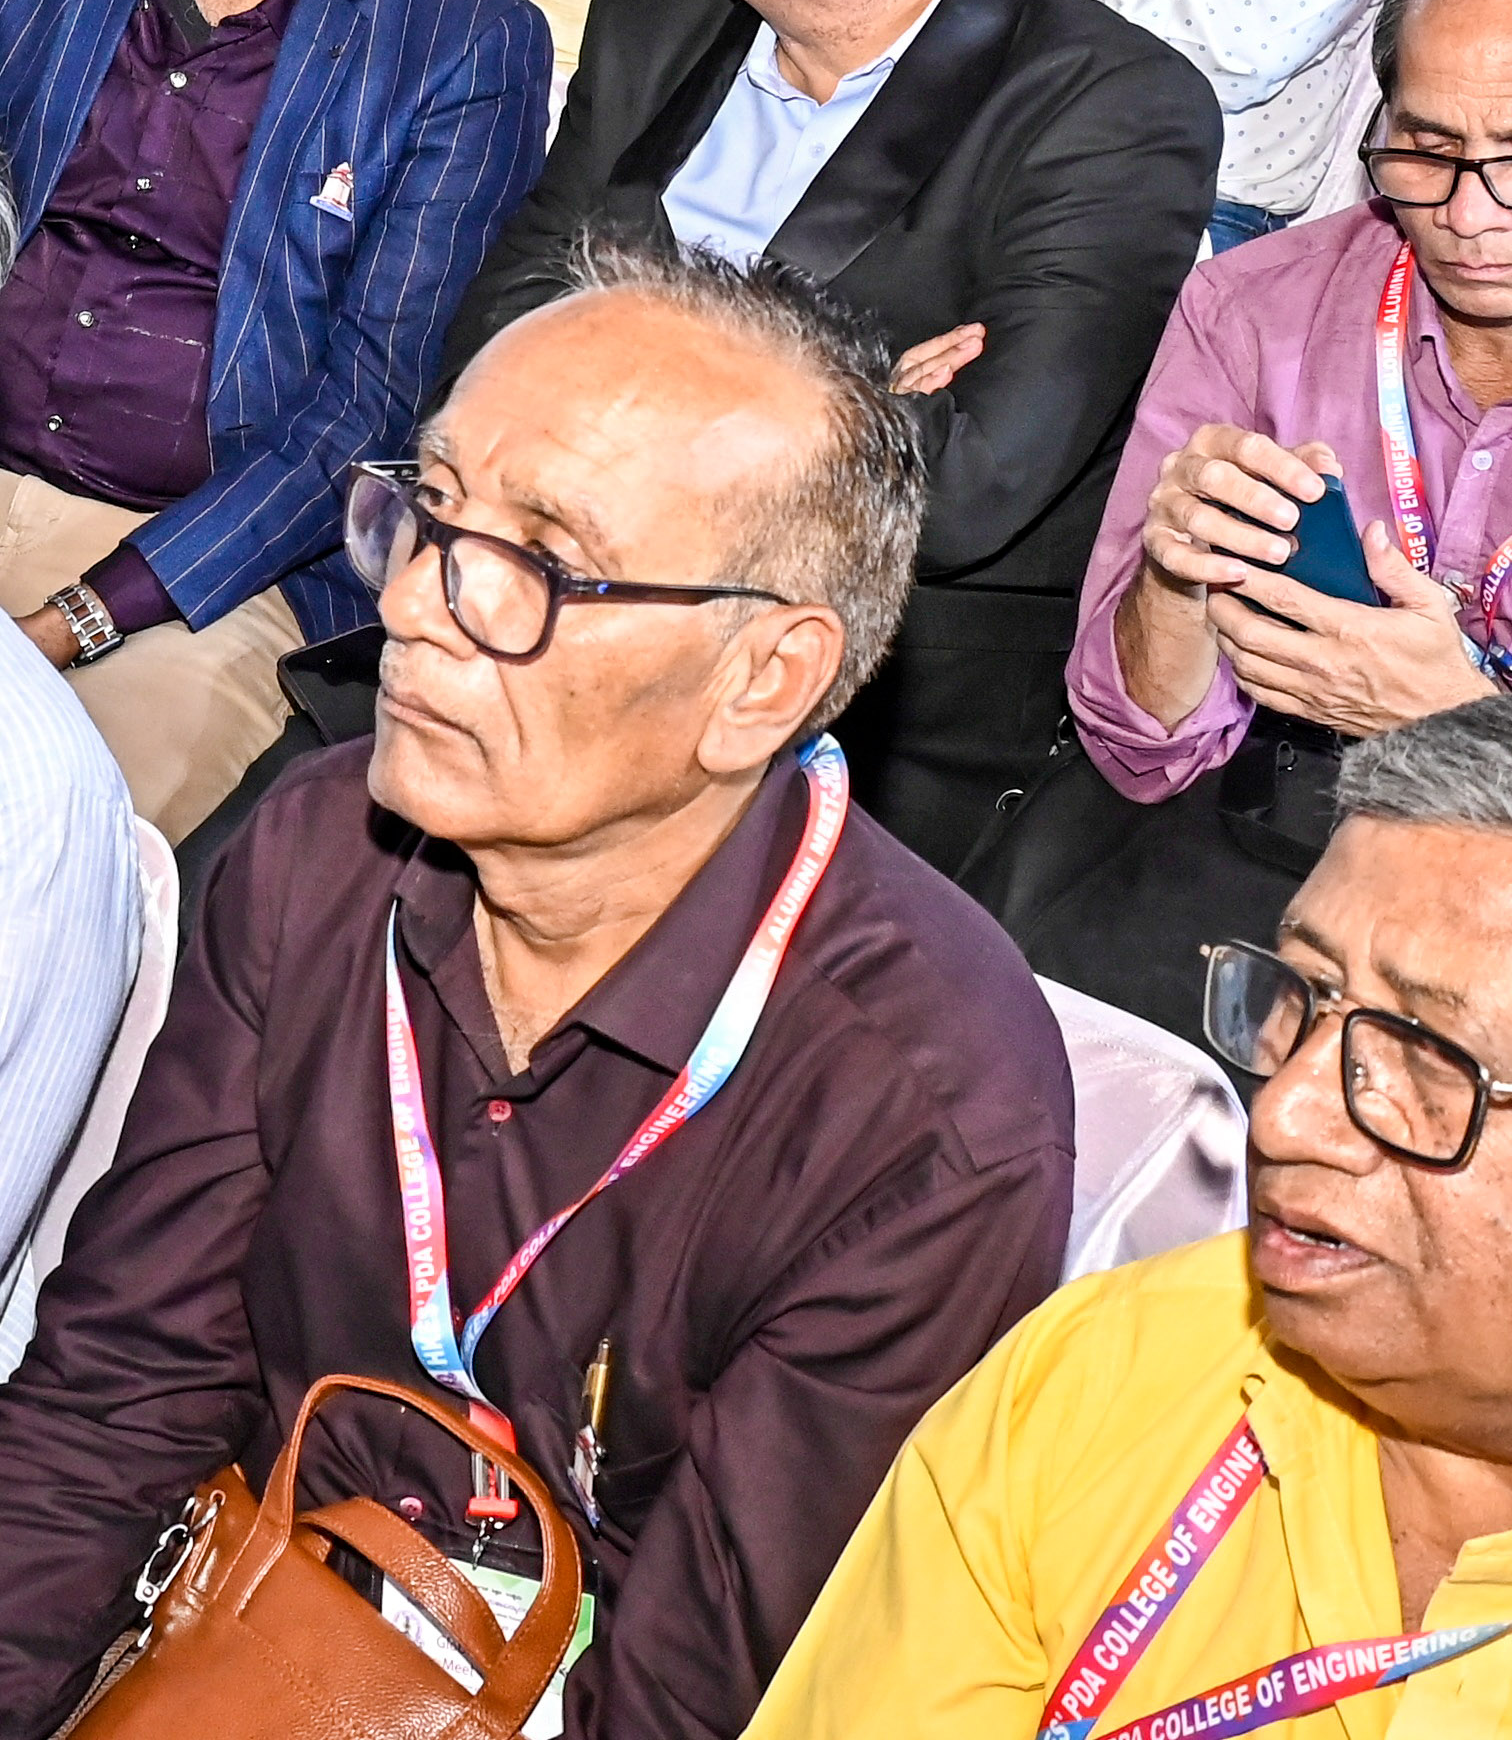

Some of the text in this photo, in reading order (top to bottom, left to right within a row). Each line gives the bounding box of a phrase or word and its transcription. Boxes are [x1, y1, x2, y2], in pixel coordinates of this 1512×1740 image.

[1383, 261, 1407, 327] ALUMNI
[1383, 324, 1405, 389] GLOBAL
[1389, 403, 1420, 508] ENGINEERING
[1405, 507, 1425, 533] OF
[1412, 527, 1430, 576] LEGE
[491, 1267, 521, 1307] PDA
[619, 1043, 733, 1171] ENGINEERING
[767, 855, 820, 944] ALUMNI
[810, 751, 846, 860] MEET-2026
[397, 1107, 418, 1142] OF
[401, 1144, 433, 1244] COLLEGE
[412, 1248, 432, 1299] PDA
[1059, 1435, 1261, 1721] PDA COLLEGE OF ENGINE
[1149, 1684, 1253, 1740] COLLEGE
[1254, 1665, 1286, 1709] OF
[1291, 1628, 1477, 1697] ENGINEERING
